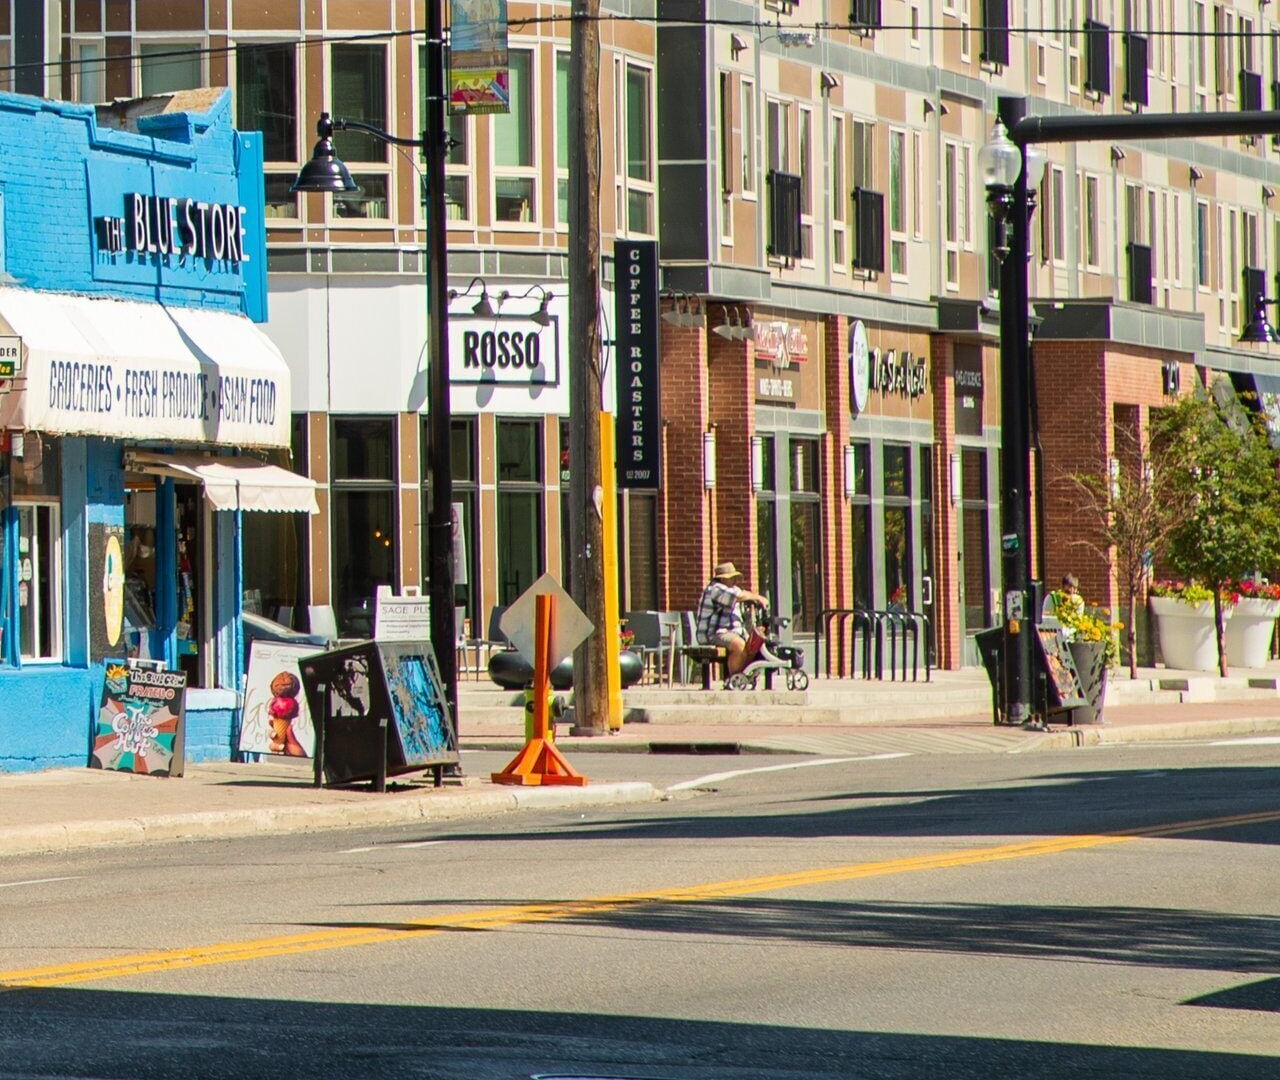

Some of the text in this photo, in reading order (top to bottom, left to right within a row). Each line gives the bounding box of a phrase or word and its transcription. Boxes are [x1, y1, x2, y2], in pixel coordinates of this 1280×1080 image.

[103, 192, 251, 263] THE BLUE STORE
[463, 330, 540, 369] ROSSO
[630, 249, 644, 462] COFFEE ROASTERS
[48, 359, 277, 426] GROCERIES FRESH PRODUCE ASIAN FOOD
[381, 606, 408, 615] SAGE
